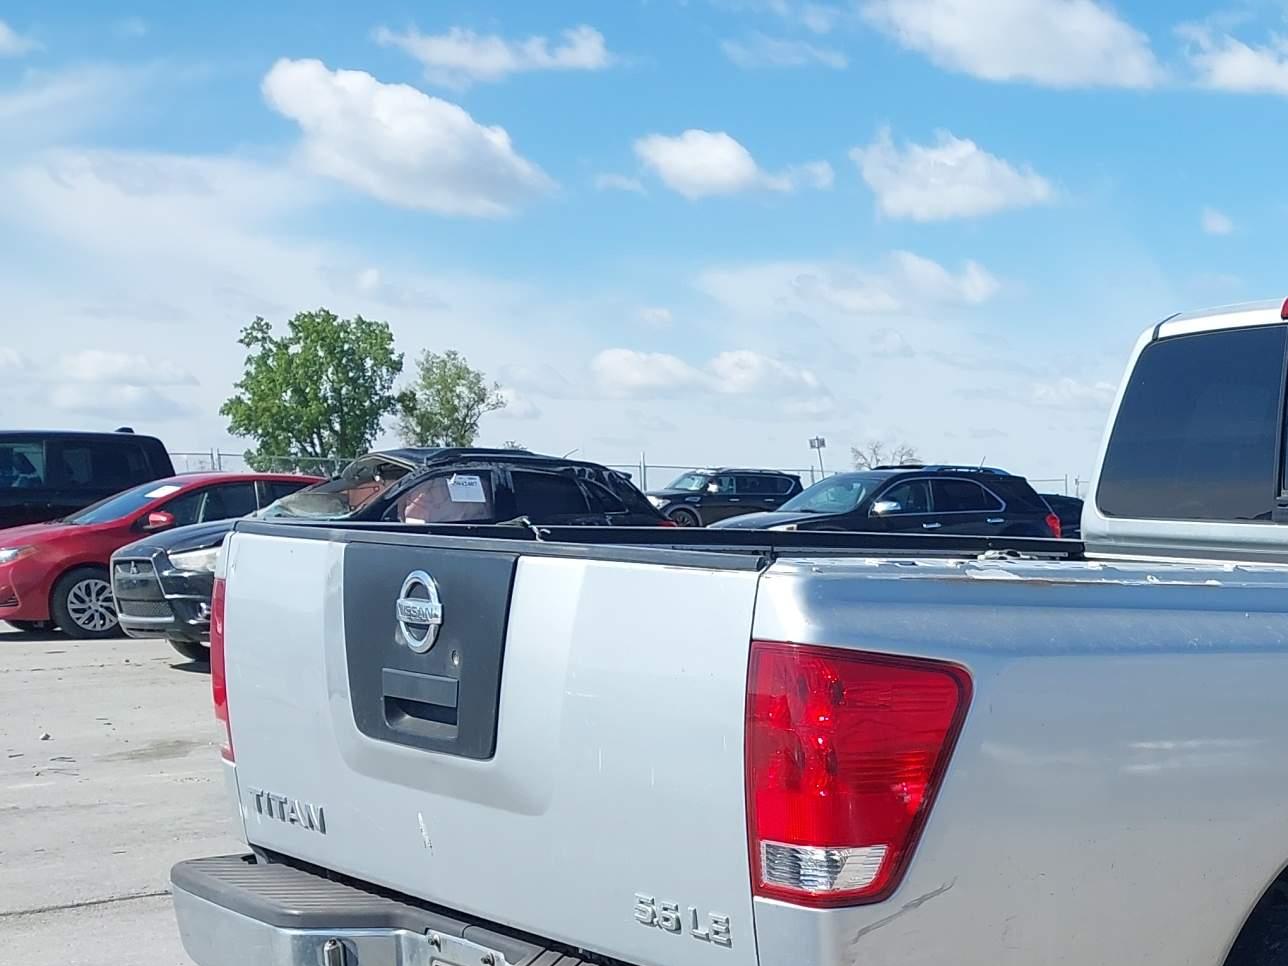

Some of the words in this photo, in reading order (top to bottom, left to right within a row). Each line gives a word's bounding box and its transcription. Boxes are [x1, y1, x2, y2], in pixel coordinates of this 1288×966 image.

[399, 602, 434, 620] NISSAN
[247, 786, 327, 835] TITAN
[687, 906, 733, 948] LE
